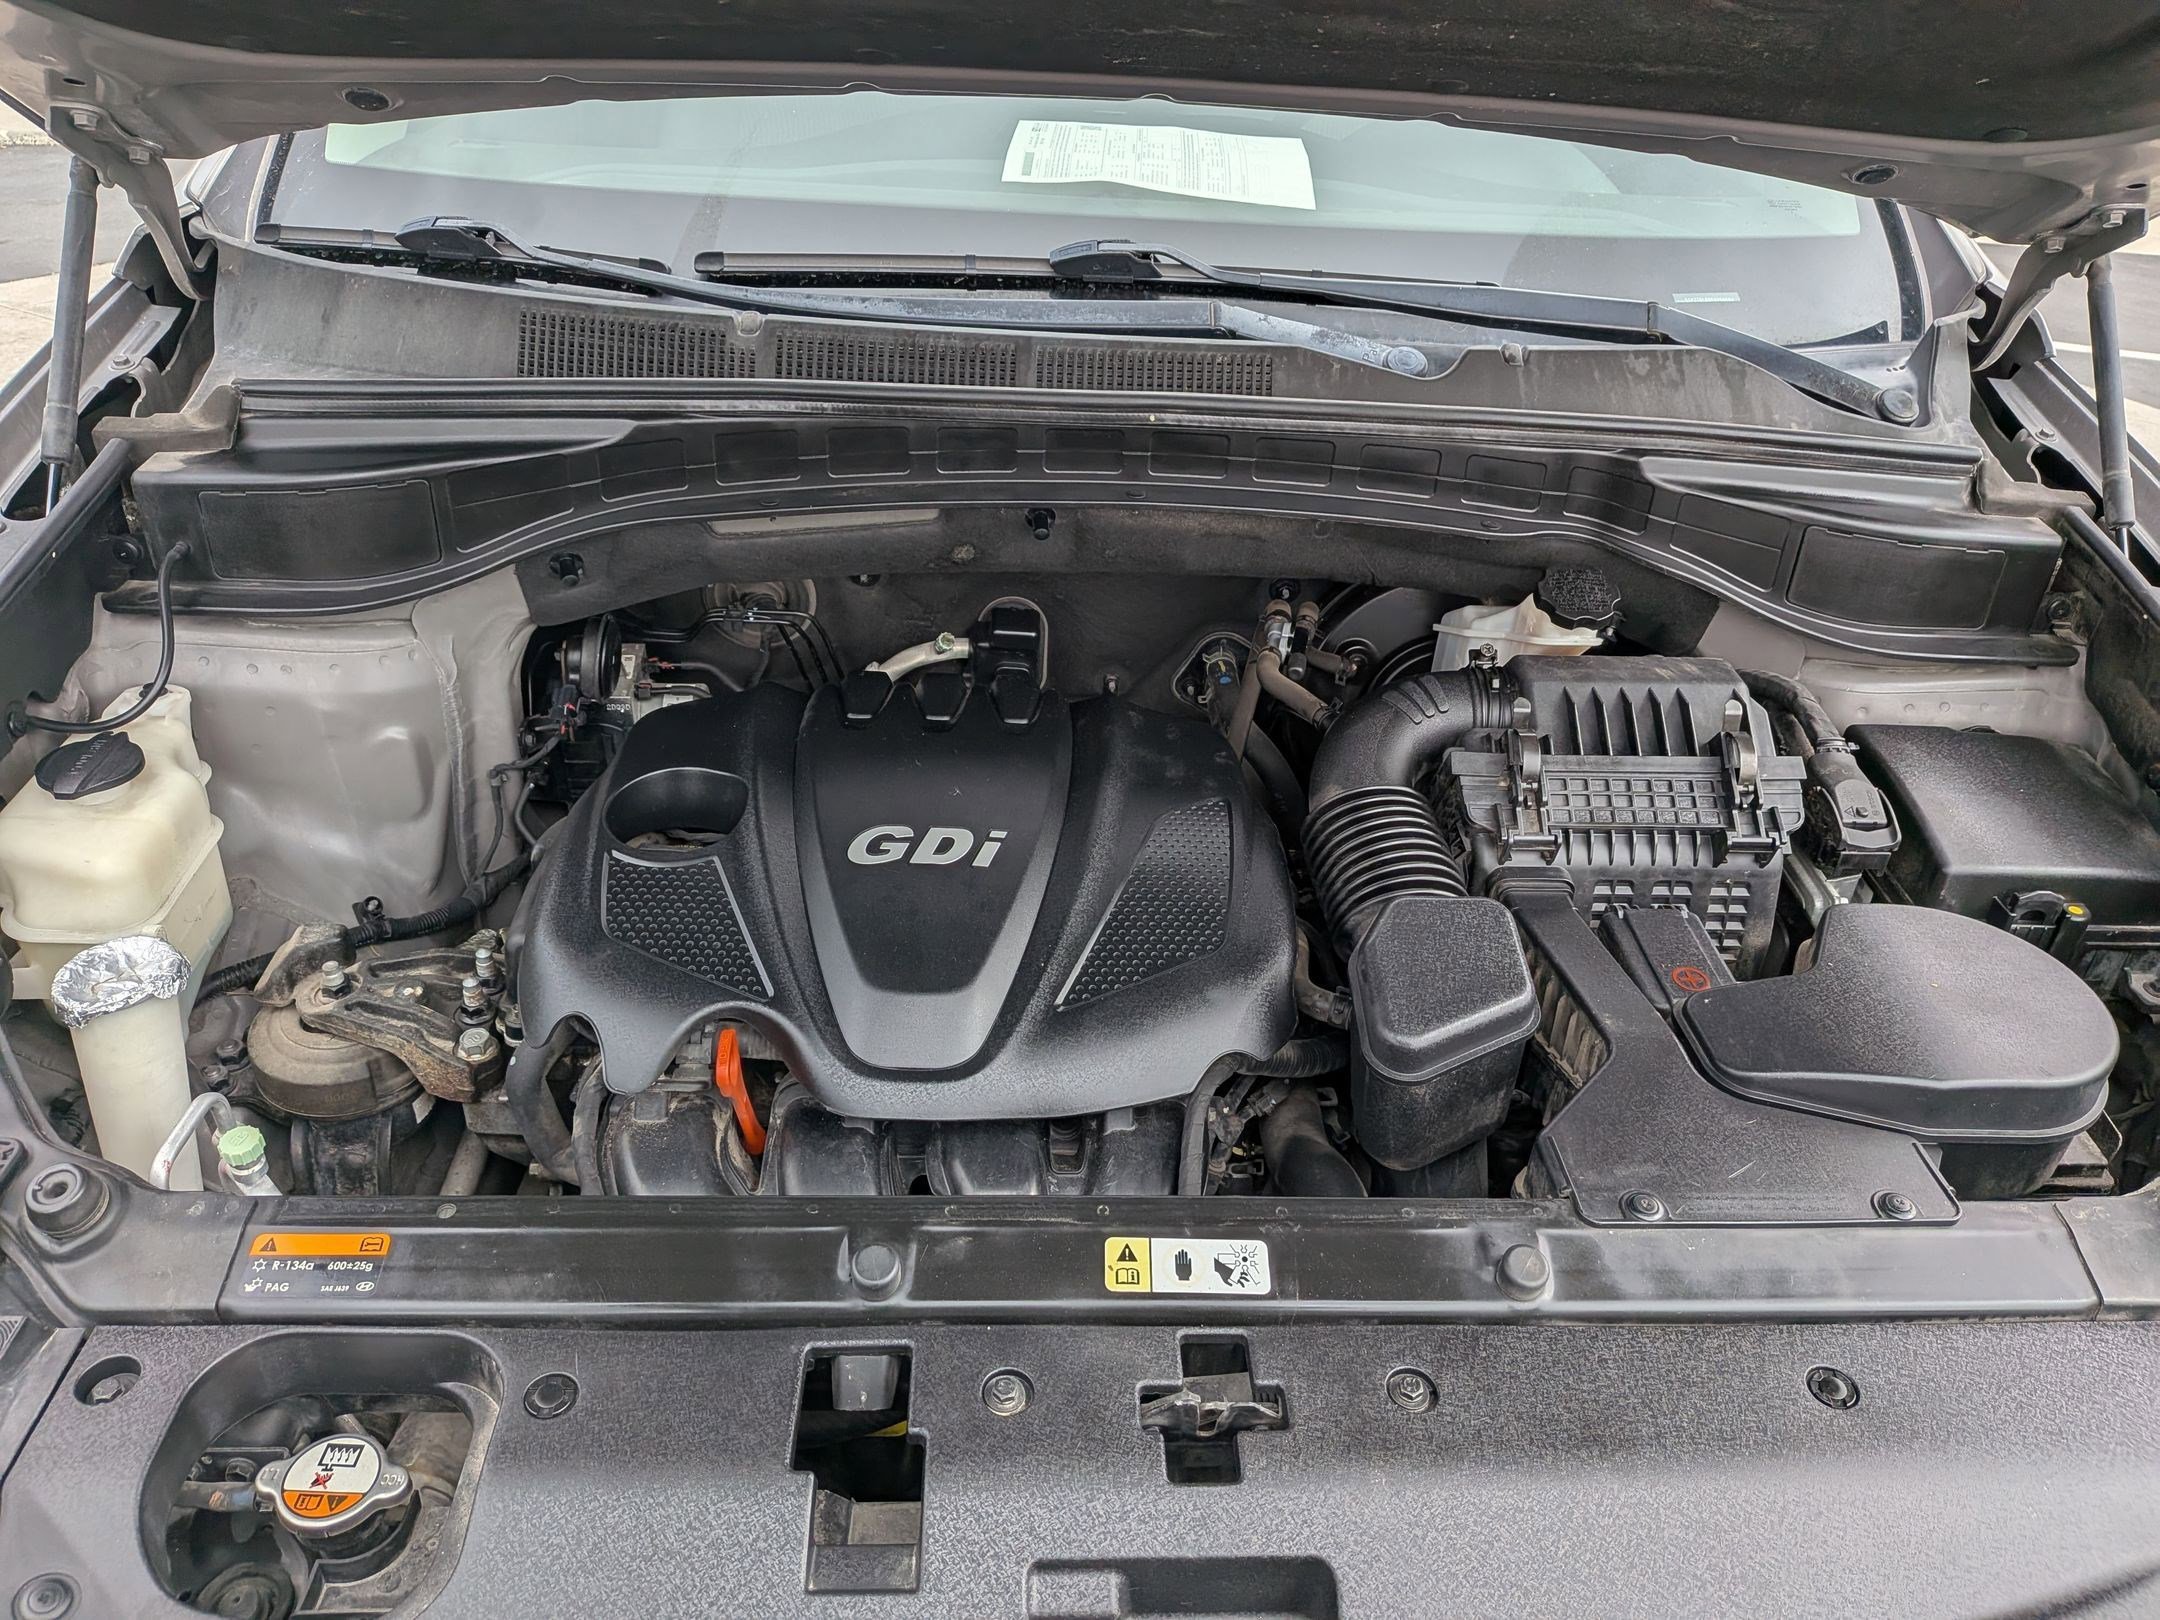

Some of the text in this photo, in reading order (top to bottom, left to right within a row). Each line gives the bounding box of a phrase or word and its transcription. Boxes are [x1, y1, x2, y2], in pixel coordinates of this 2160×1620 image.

[846, 824, 1009, 868] GDi
[271, 1260, 374, 1273] R-134a 600±25g
[264, 1282, 290, 1293] PAG
[380, 1473, 405, 1486] HCC
